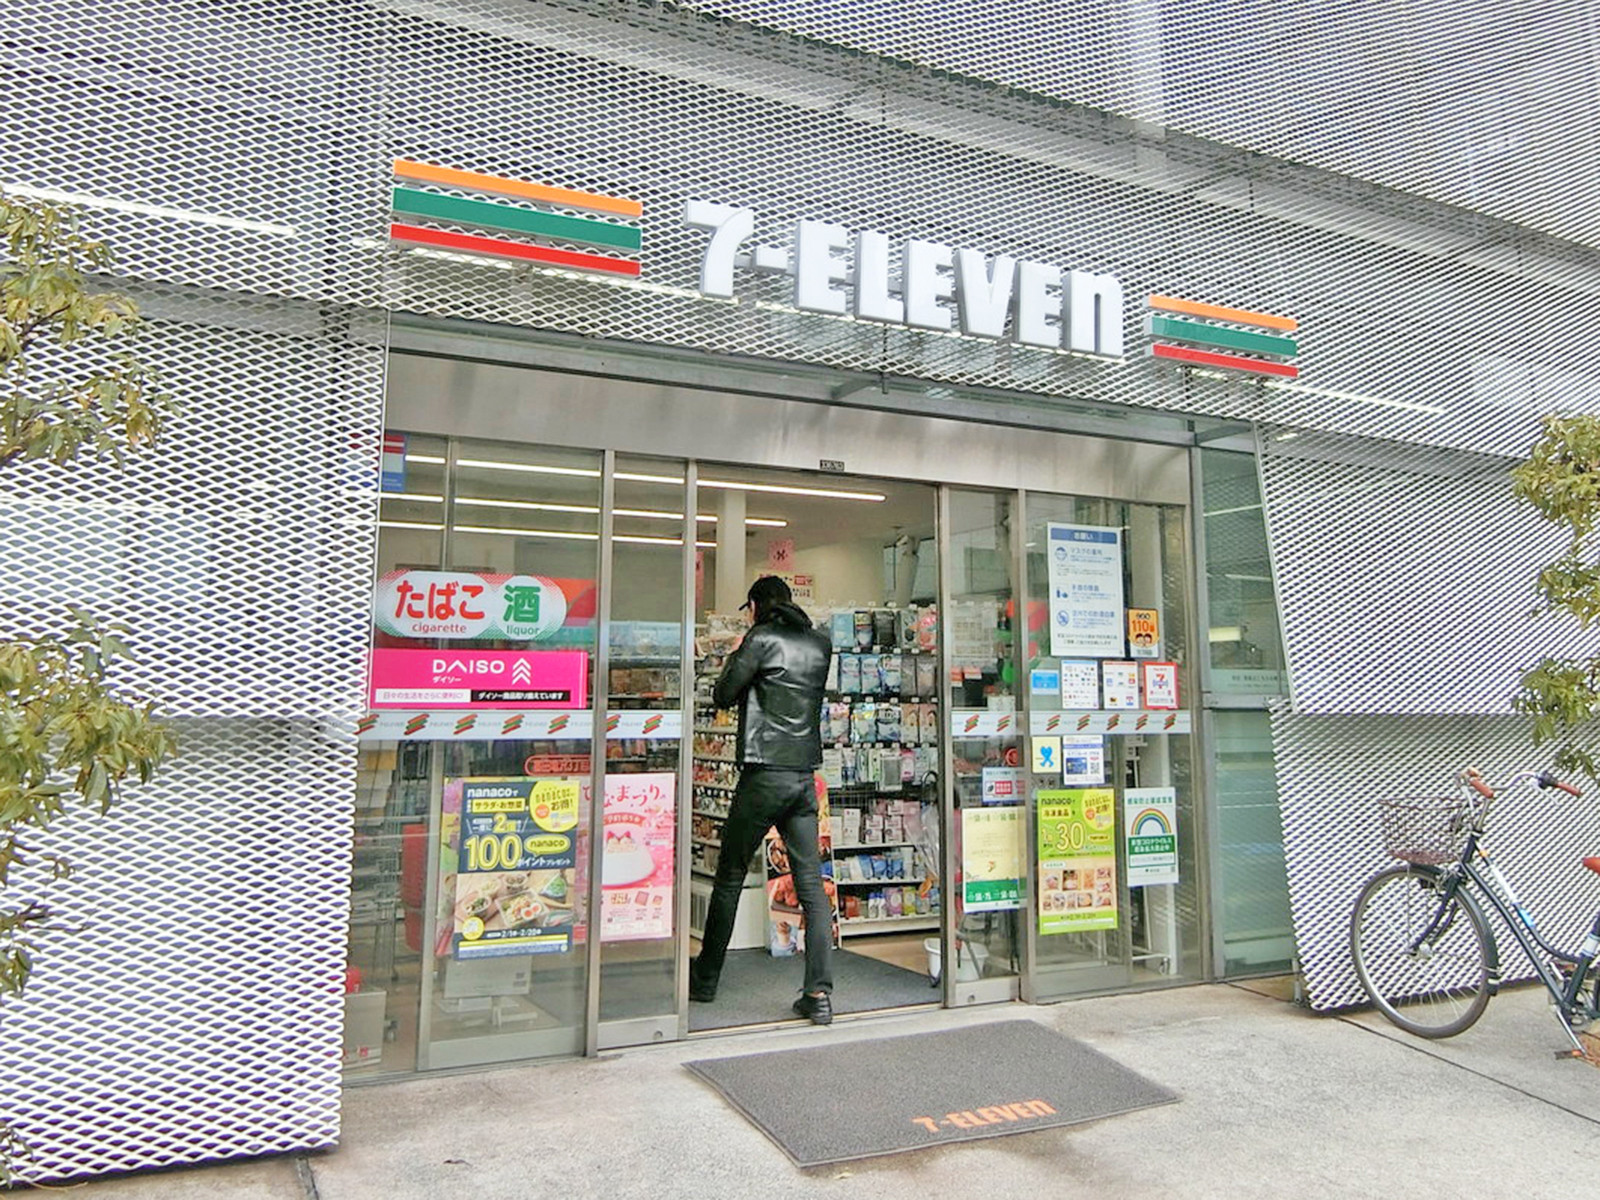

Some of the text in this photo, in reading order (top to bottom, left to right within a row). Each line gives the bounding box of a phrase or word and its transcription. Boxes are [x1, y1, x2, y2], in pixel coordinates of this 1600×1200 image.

[395, 580, 541, 623] たばこ 酒
[412, 622, 540, 636] cigarette liquor
[432, 659, 505, 674] DAISO
[433, 675, 462, 684] ダイソー
[1055, 822, 1085, 852] 30
[464, 834, 566, 871] 100 nanaco
